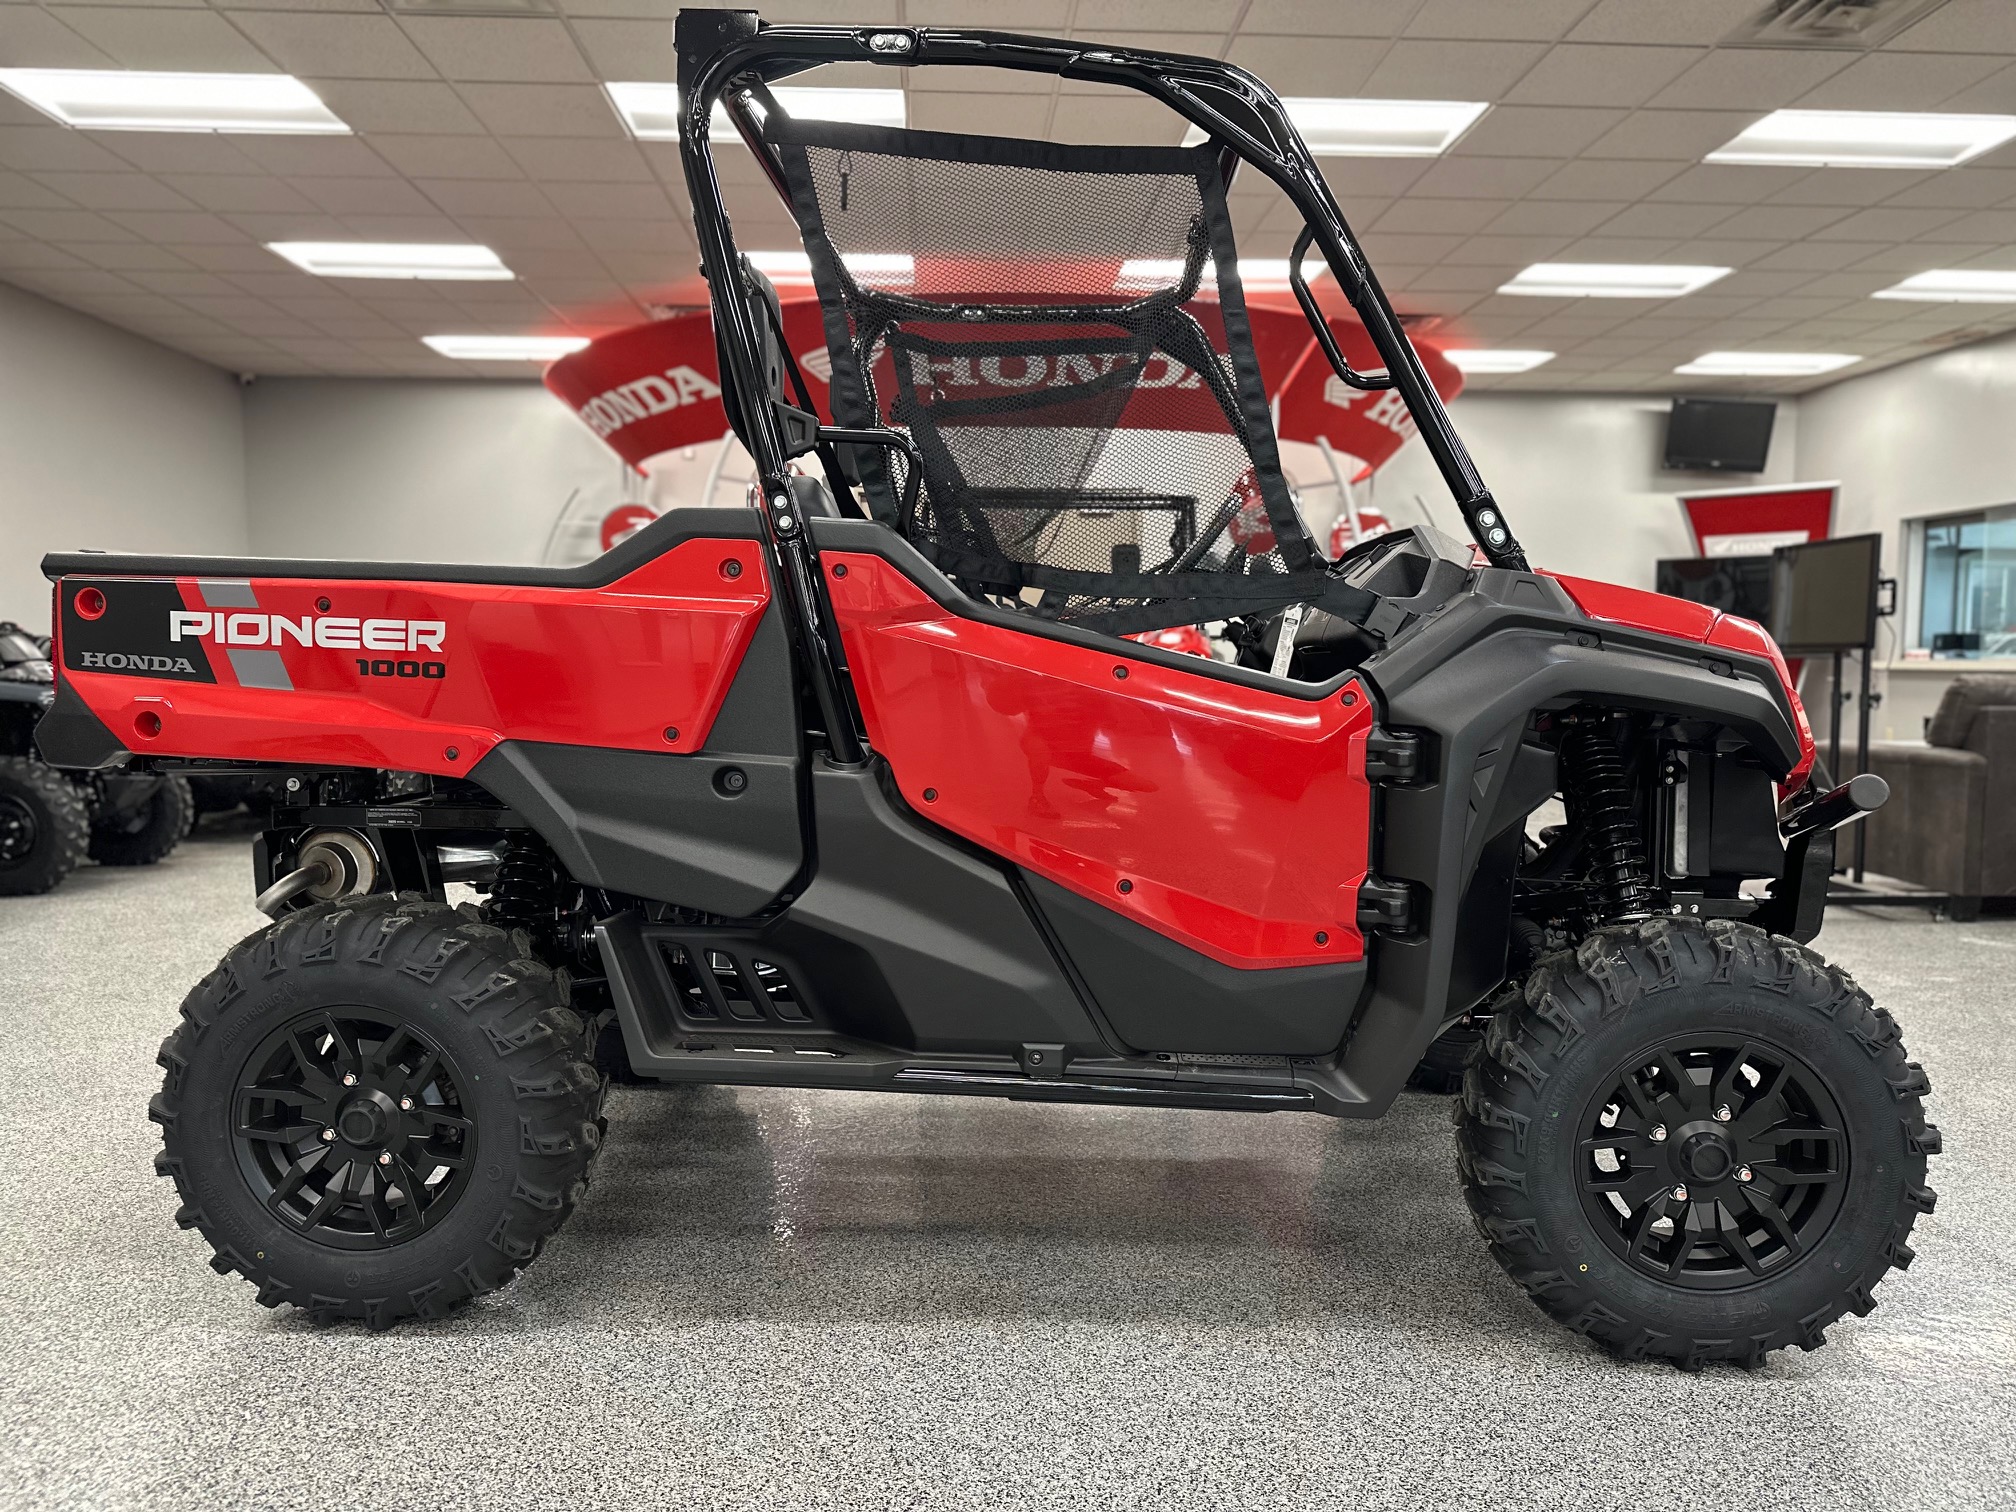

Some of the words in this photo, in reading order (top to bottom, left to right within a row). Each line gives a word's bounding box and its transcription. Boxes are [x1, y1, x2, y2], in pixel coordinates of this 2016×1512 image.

[170, 611, 446, 652] PIONEER
[81, 652, 196, 673] HONDA
[356, 659, 446, 679] 1000
